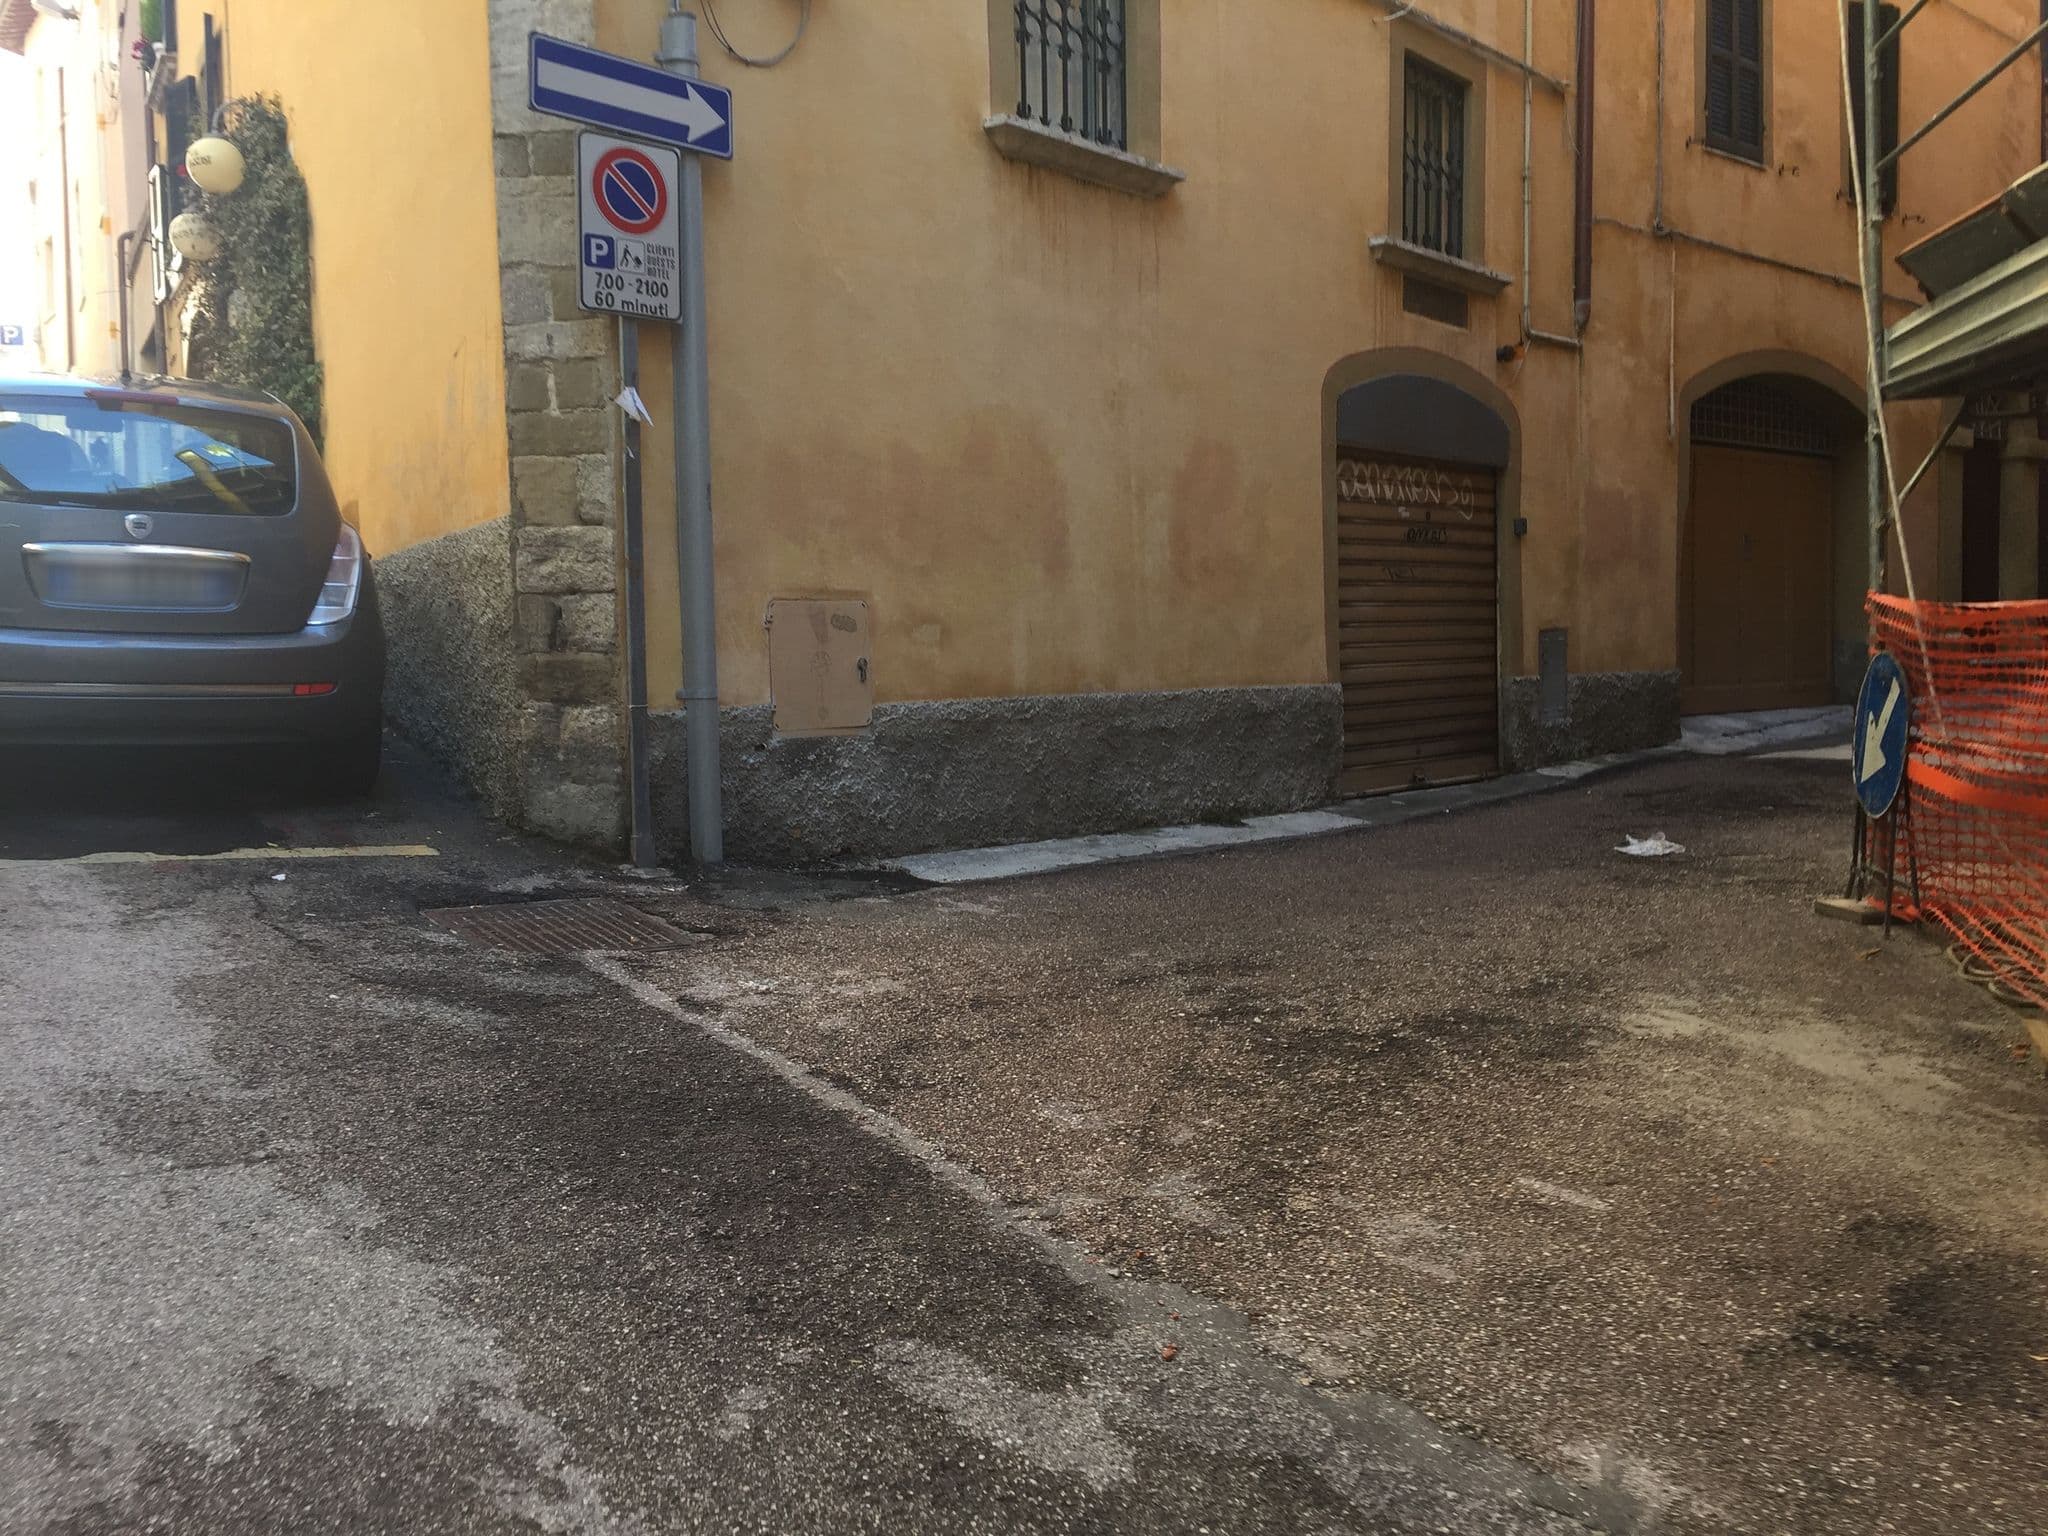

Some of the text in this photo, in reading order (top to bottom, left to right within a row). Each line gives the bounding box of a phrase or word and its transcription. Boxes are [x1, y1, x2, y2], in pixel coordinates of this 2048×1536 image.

[590, 238, 609, 264] P
[647, 243, 675, 258] CLIENTI
[647, 266, 670, 281] HOTEL
[595, 291, 615, 308] 60
[621, 298, 669, 317] minuti
[3, 326, 19, 344] P
